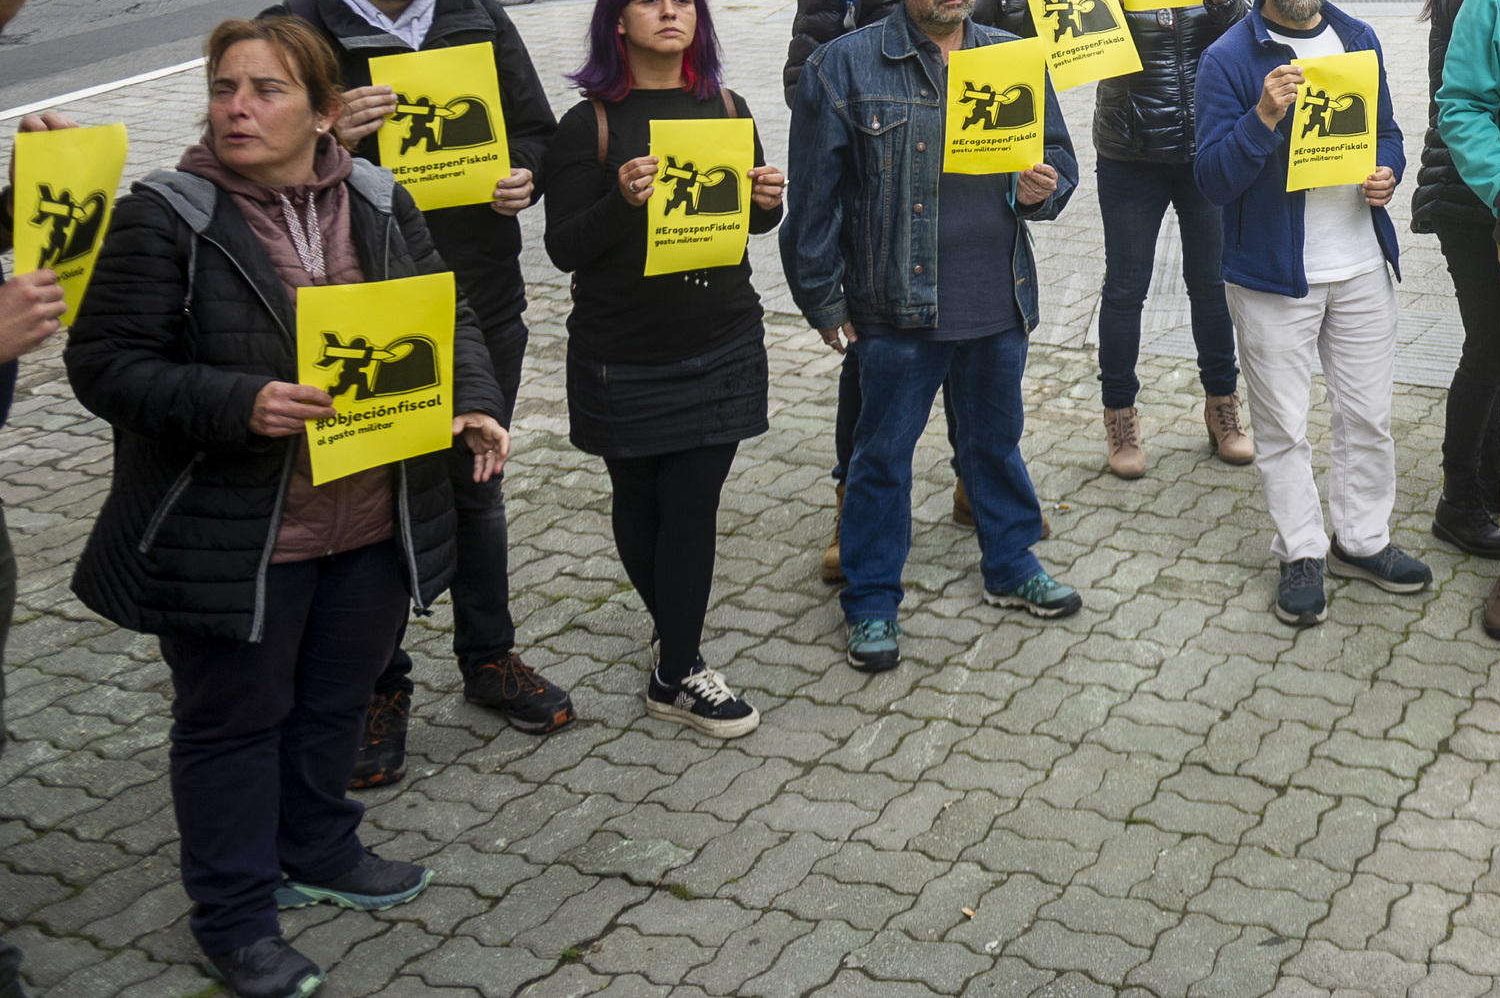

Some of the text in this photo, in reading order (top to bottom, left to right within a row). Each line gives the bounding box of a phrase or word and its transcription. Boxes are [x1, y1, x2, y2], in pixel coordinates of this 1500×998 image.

[1051, 36, 1125, 59] #EragozpenFiskala
[1053, 49, 1105, 69] gastu militarrari
[952, 131, 1037, 146] #EragozpenFiskala
[1294, 142, 1369, 156] #EragozpenFiskala
[391, 152, 499, 175] #EragozpenFiskala
[1293, 154, 1344, 167] gastu militarrari
[397, 169, 466, 185] astu militarrari
[655, 221, 741, 236] #EragozpenFiskala
[654, 235, 713, 247] gastu militarrari
[315, 394, 442, 431] #Objeciónfiscal
[317, 421, 394, 446] al gasto militar
